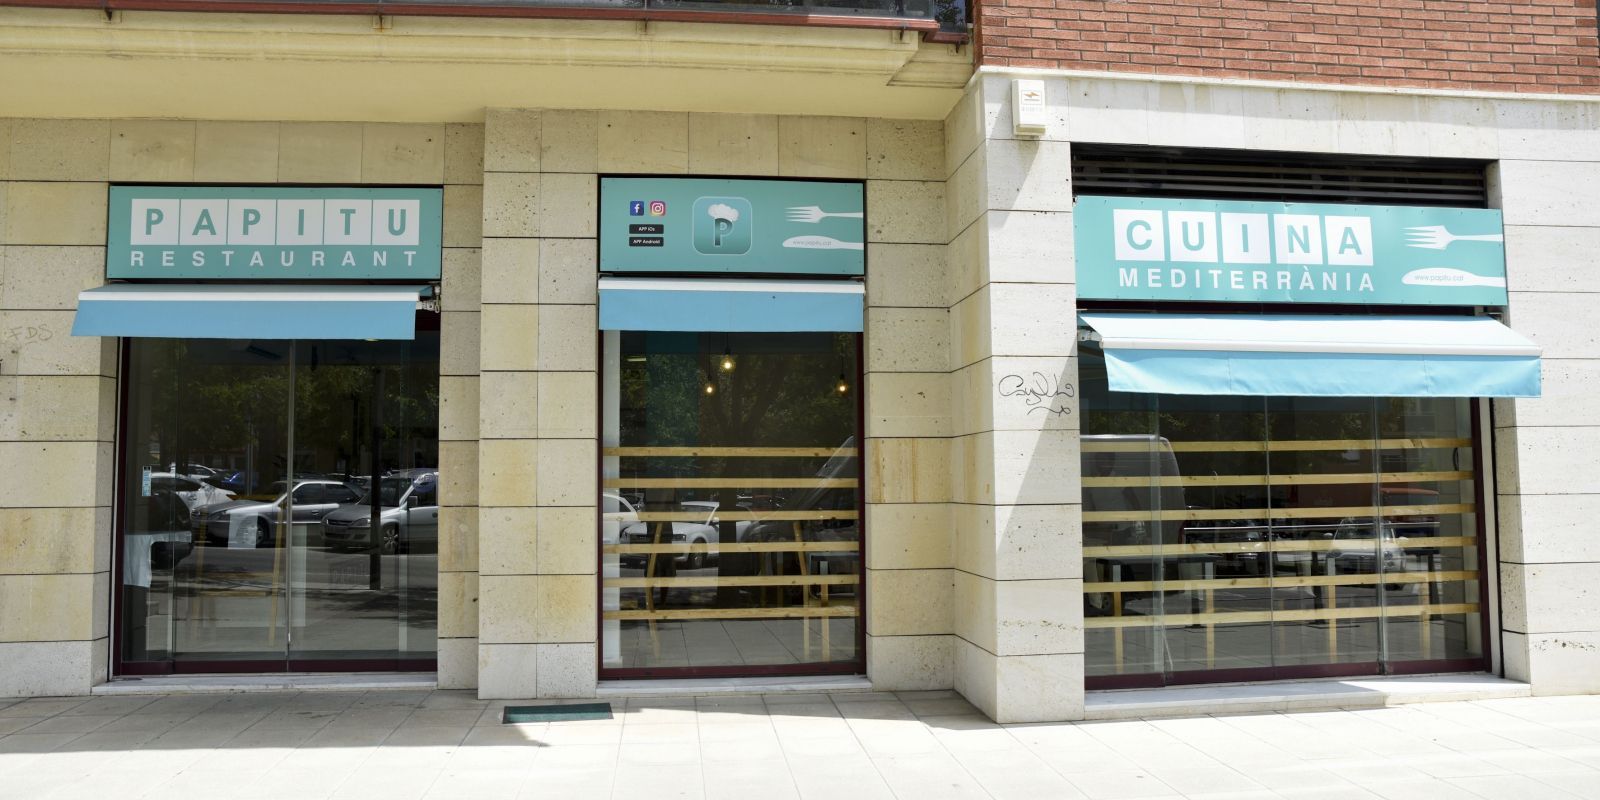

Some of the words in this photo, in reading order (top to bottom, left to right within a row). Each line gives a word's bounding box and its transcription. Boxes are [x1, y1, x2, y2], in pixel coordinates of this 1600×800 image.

[145, 208, 407, 236] PAPITU
[1126, 219, 1363, 256] CUINA
[130, 250, 417, 267] RESTAURANT
[1118, 266, 1375, 292] MEDITERRÀNIA
